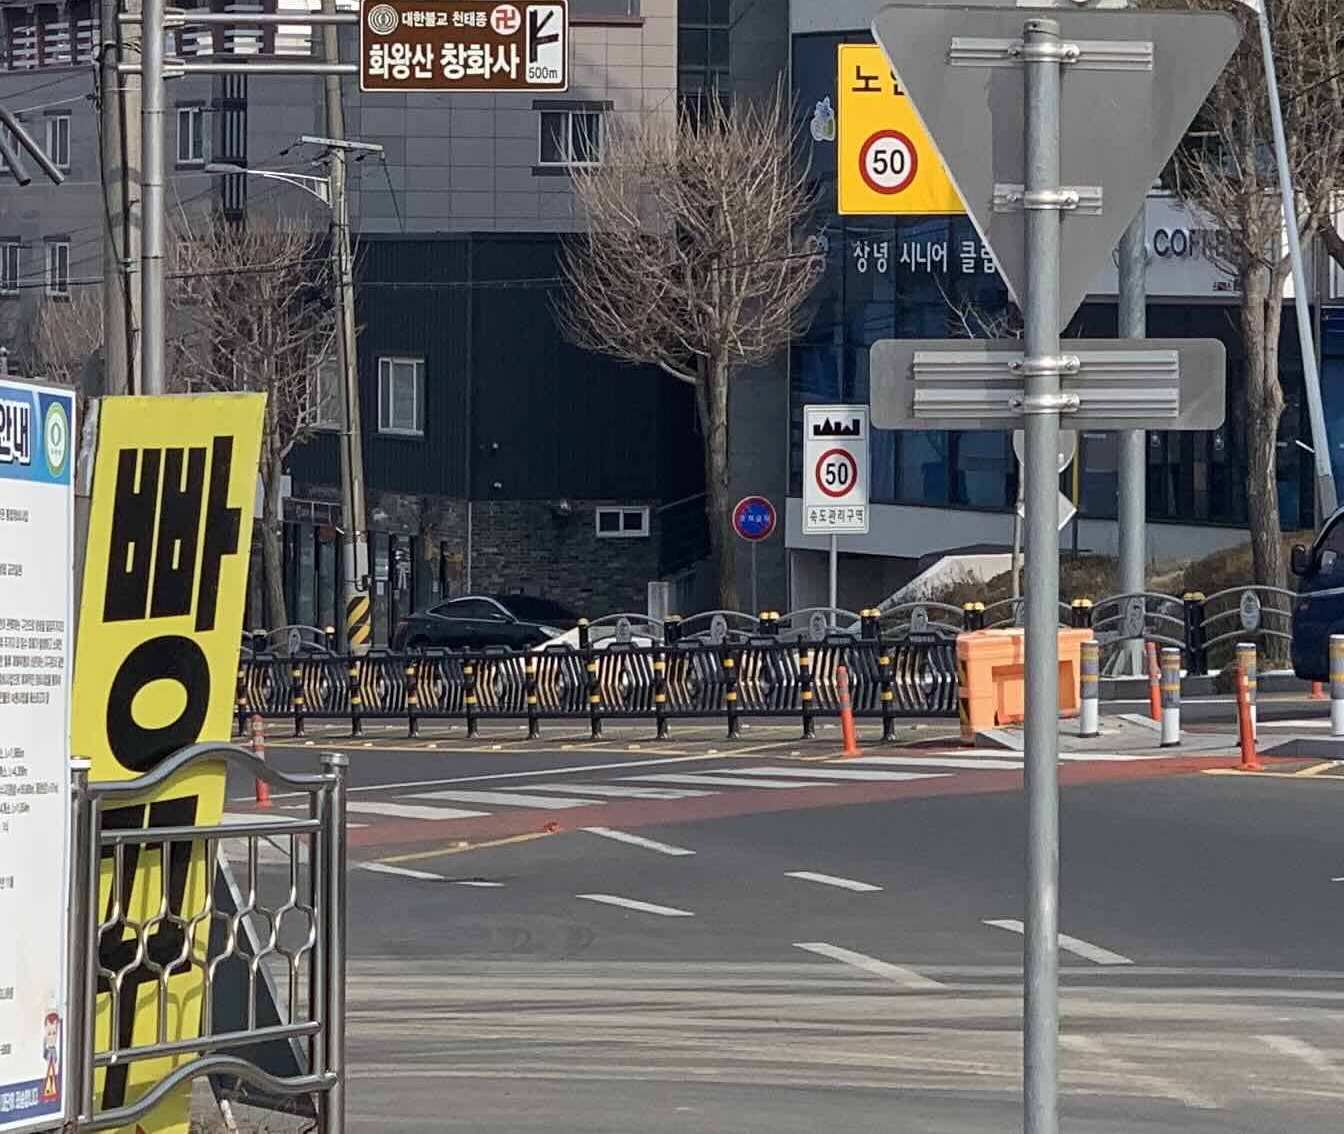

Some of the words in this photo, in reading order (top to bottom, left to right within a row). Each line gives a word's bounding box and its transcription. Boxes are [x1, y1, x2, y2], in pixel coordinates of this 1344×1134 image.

[402, 11, 448, 27] 대한불교
[453, 11, 488, 27] 천태종
[369, 43, 434, 80] 화왕산
[440, 43, 520, 80] 창화사
[529, 67, 558, 79] 500m
[873, 150, 904, 175] 50
[900, 241, 949, 273] 시니어
[825, 463, 849, 485] 50
[810, 509, 864, 524] 속도관리구역
